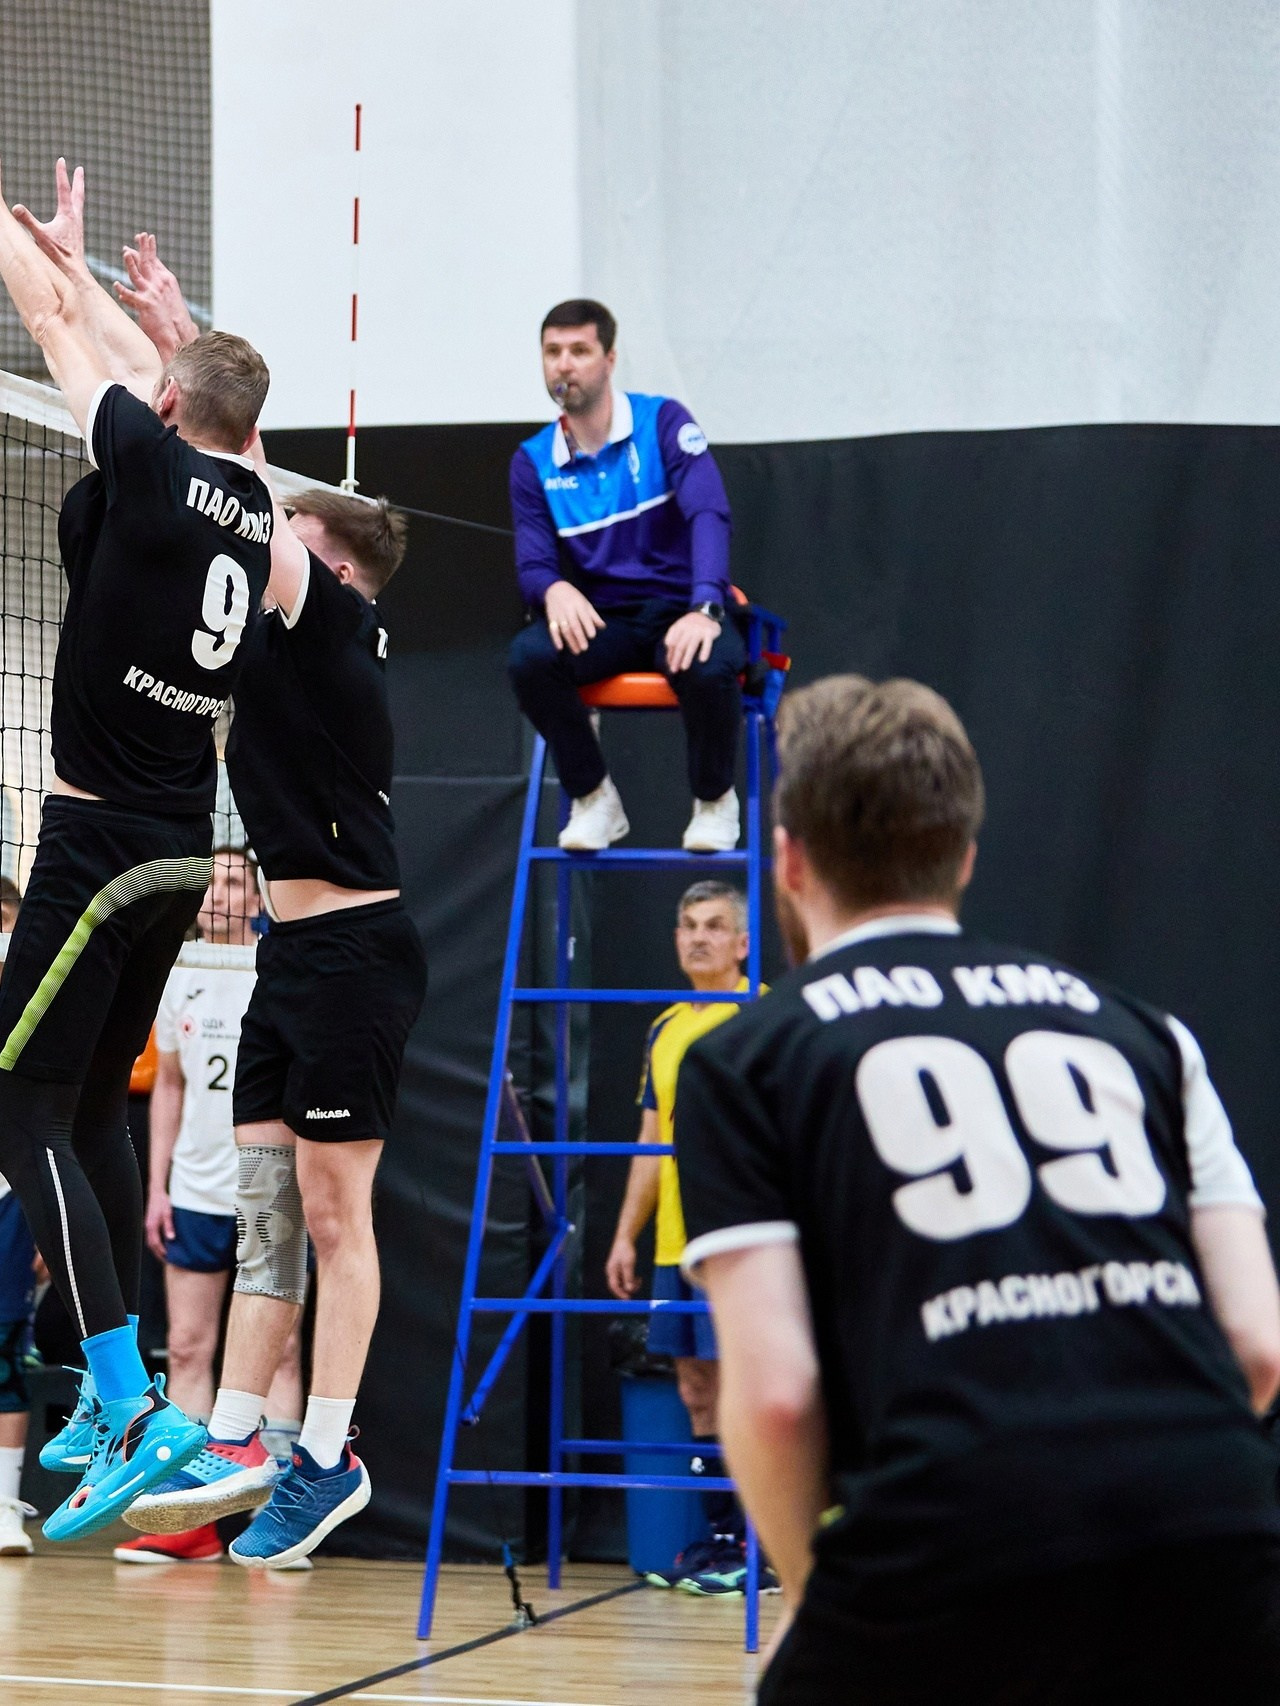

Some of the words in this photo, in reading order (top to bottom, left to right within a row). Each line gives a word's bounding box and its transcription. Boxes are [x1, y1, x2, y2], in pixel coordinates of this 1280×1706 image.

[186, 476, 241, 527] ПАО
[192, 553, 250, 670] 9
[122, 665, 227, 719] КРАСНОГОРС
[801, 965, 944, 1022] ПАО
[951, 963, 1101, 1014] КМЗ
[207, 1054, 229, 1091] 2
[854, 1029, 1167, 1242] 99
